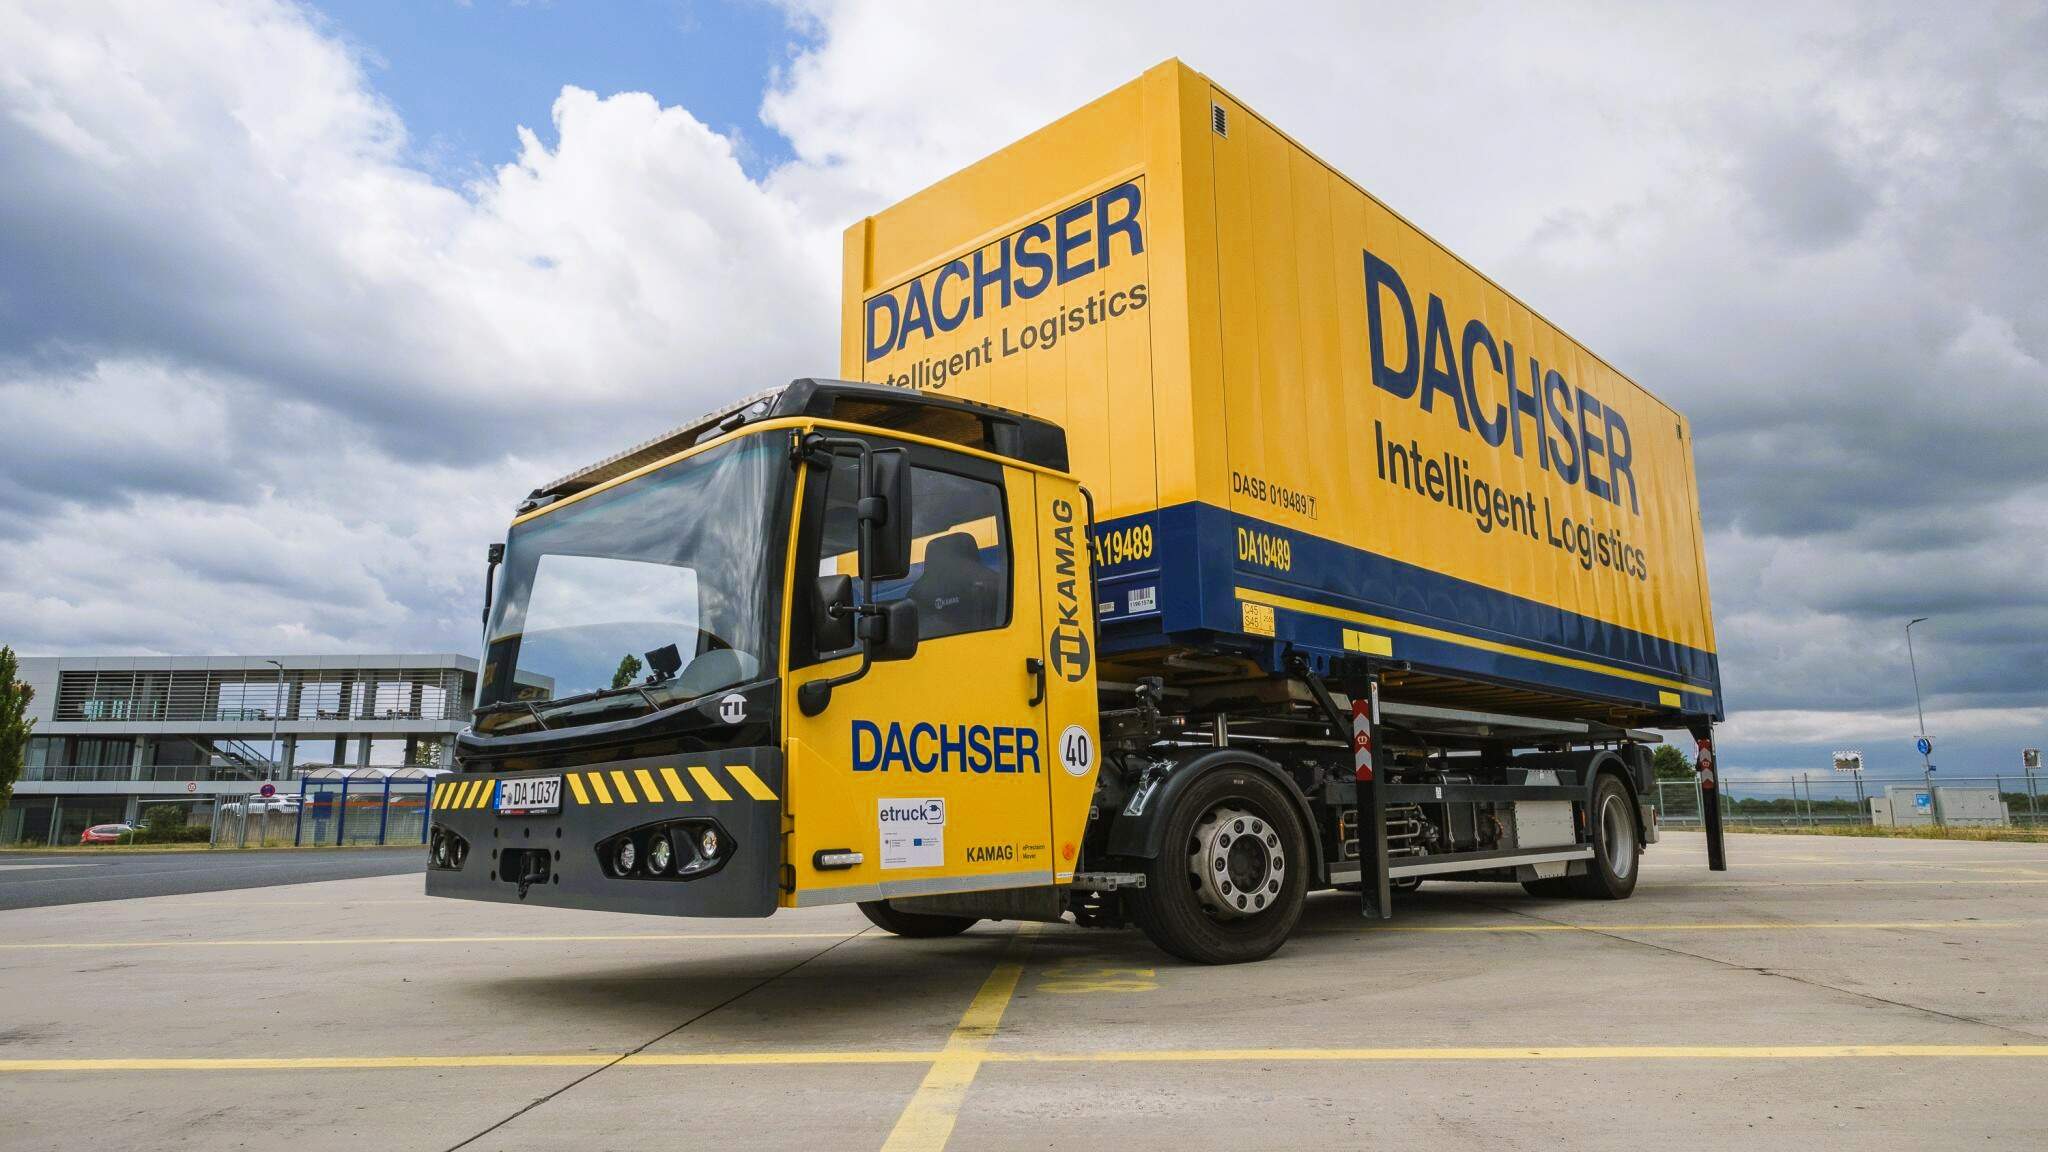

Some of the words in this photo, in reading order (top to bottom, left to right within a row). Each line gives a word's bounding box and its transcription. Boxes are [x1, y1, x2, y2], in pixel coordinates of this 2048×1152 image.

[866, 183, 1144, 363] DACHSER
[867, 336, 993, 390] telligent
[1002, 284, 1148, 357] Logistics
[1362, 248, 1640, 517] DACHSER
[1233, 471, 1267, 502] DASB
[1270, 484, 1307, 515] 019489
[1374, 419, 1540, 541] Intelligent
[1544, 496, 1648, 582] Logistics
[1052, 499, 1080, 627] KAMAG
[1092, 524, 1153, 567] A19489
[1238, 527, 1291, 572] DA19489
[851, 720, 1041, 773] DACHSER
[1065, 734, 1088, 767] 40
[500, 783, 508, 805] F
[513, 782, 528, 805] DA
[529, 780, 559, 805] 1037
[880, 804, 928, 822] etruck
[966, 844, 1014, 863] KAMAG
